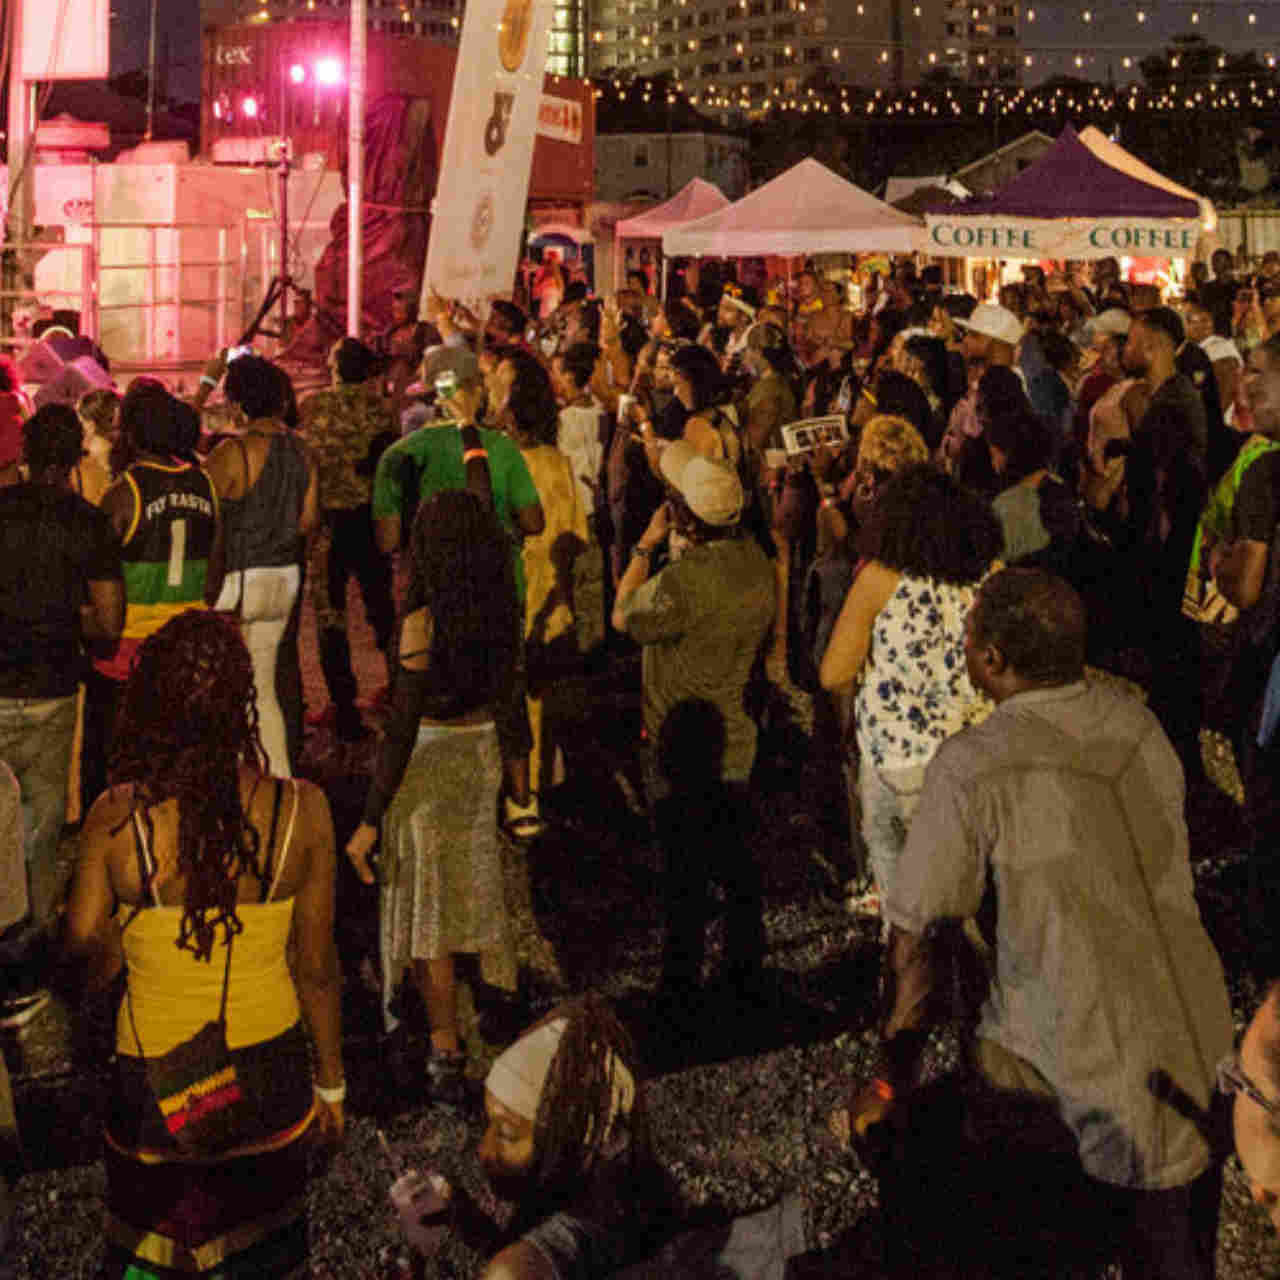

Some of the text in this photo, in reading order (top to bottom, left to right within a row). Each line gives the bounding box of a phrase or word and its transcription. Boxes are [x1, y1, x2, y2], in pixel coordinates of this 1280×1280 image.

[931, 223, 1194, 250] COFFEE COFFEE
[167, 519, 187, 589] 1
